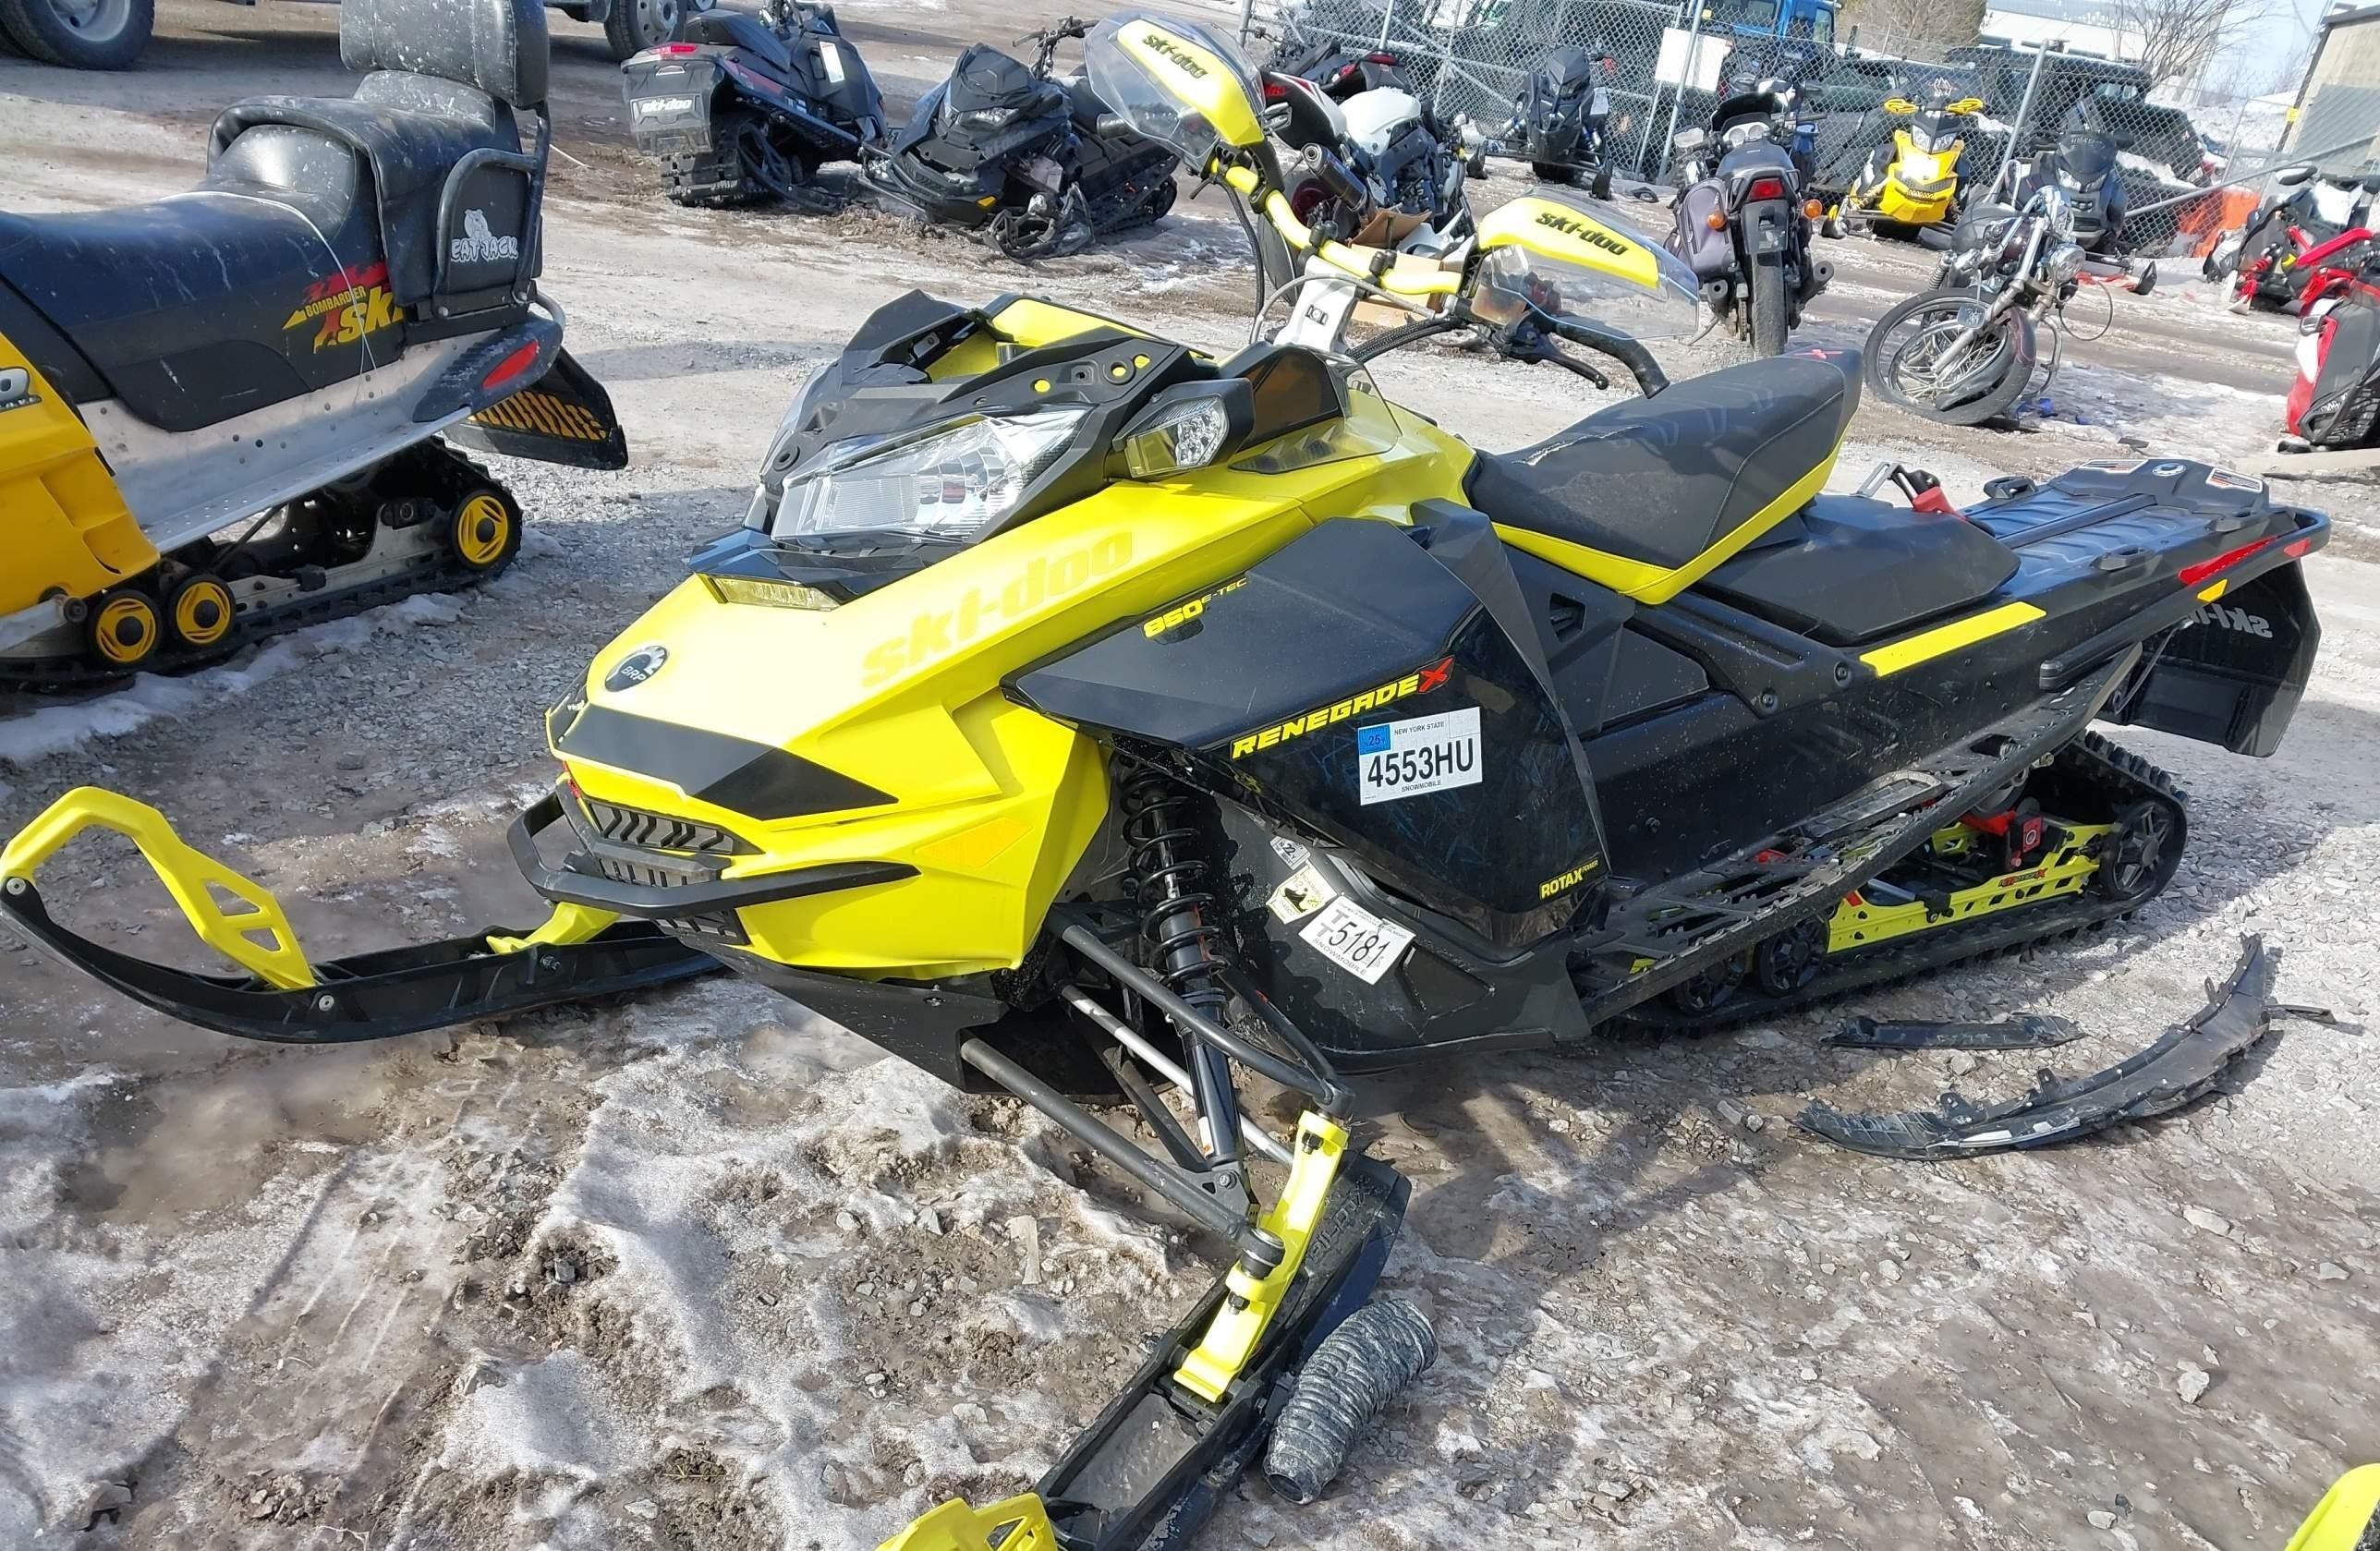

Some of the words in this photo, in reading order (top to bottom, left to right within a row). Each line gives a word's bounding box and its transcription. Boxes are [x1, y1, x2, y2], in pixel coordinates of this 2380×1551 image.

[640, 98, 692, 113] ski-doo
[1536, 212, 1629, 256] ski-doo
[304, 285, 367, 318] BOMBARDIER
[860, 531, 1134, 688] ski-doo
[1143, 599, 1204, 638] 850
[1201, 577, 1247, 604] E-TEC
[620, 665, 647, 681] BRP
[1368, 733, 1381, 746] 25
[1394, 727, 1408, 736] NEW
[1409, 723, 1426, 733] YORK
[1426, 721, 1445, 731] STATE
[1367, 737, 1475, 788] 4553HU
[1401, 779, 1442, 793] SNOWMOBILE
[1282, 842, 1296, 856] 22
[1540, 867, 1584, 900] ROTAX
[1313, 937, 1367, 976] SNOWMOBILE
[1328, 921, 1390, 969] 5181
